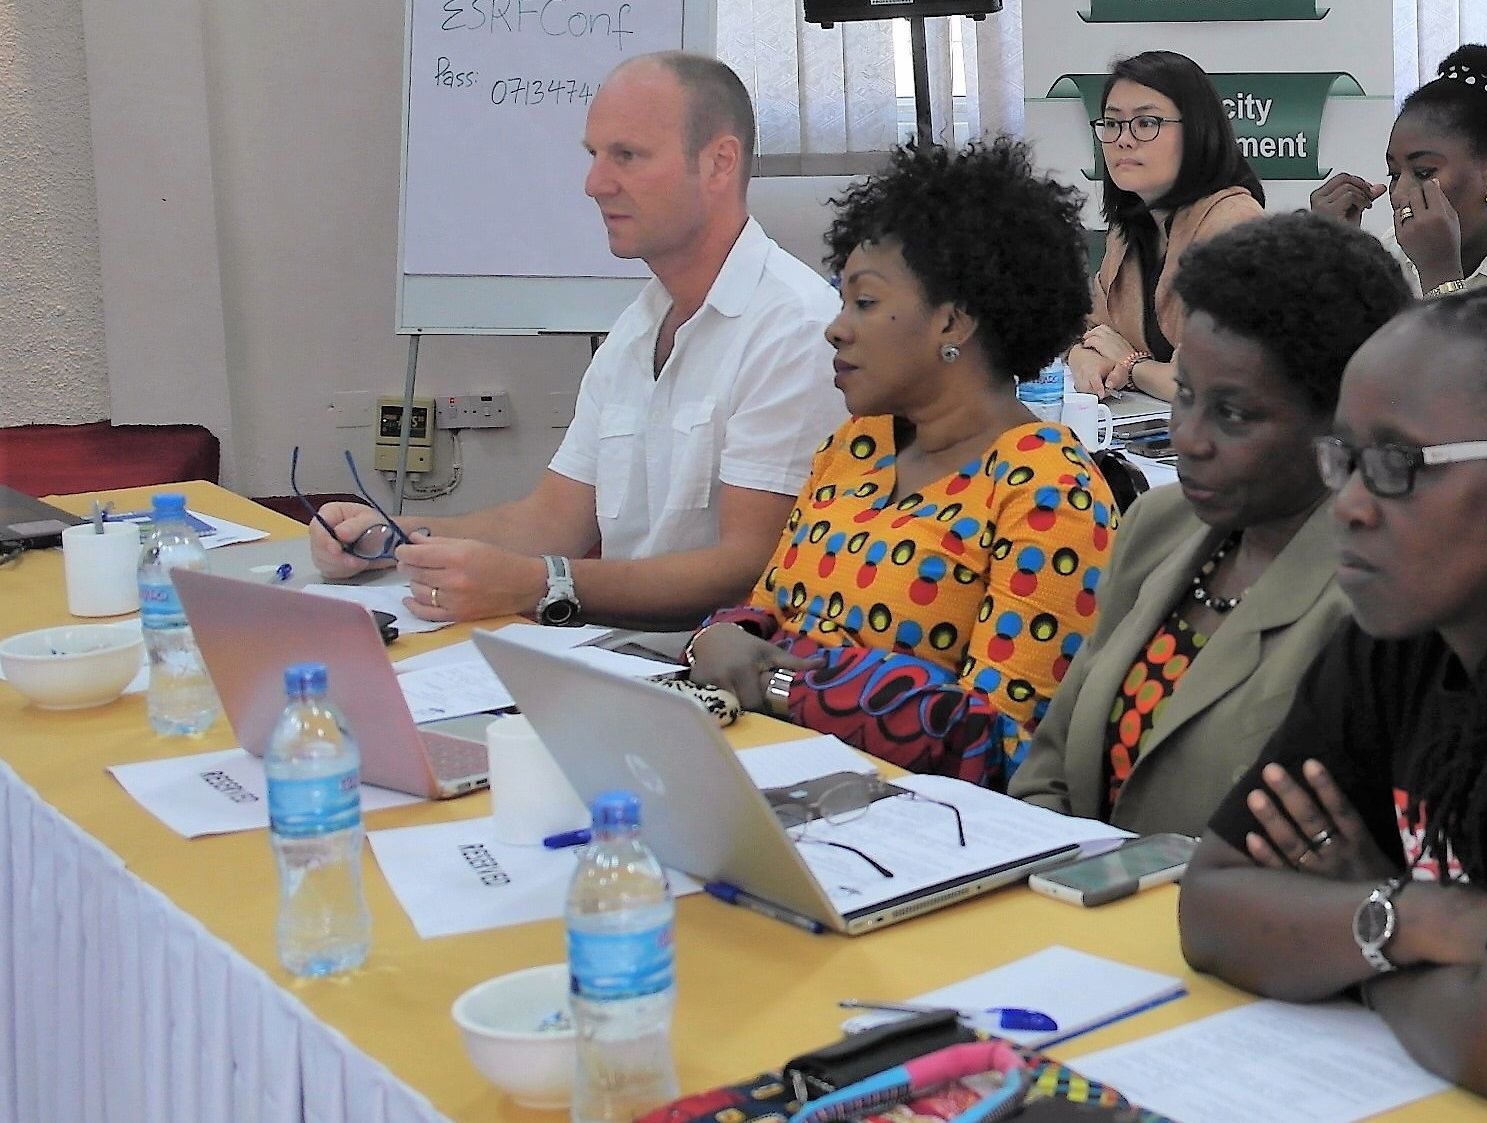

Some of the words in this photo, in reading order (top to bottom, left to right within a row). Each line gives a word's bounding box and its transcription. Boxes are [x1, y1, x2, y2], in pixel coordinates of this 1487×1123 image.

[435, 56, 479, 88] Pass:
[491, 78, 600, 105] 0713474
[1222, 92, 1273, 126] city
